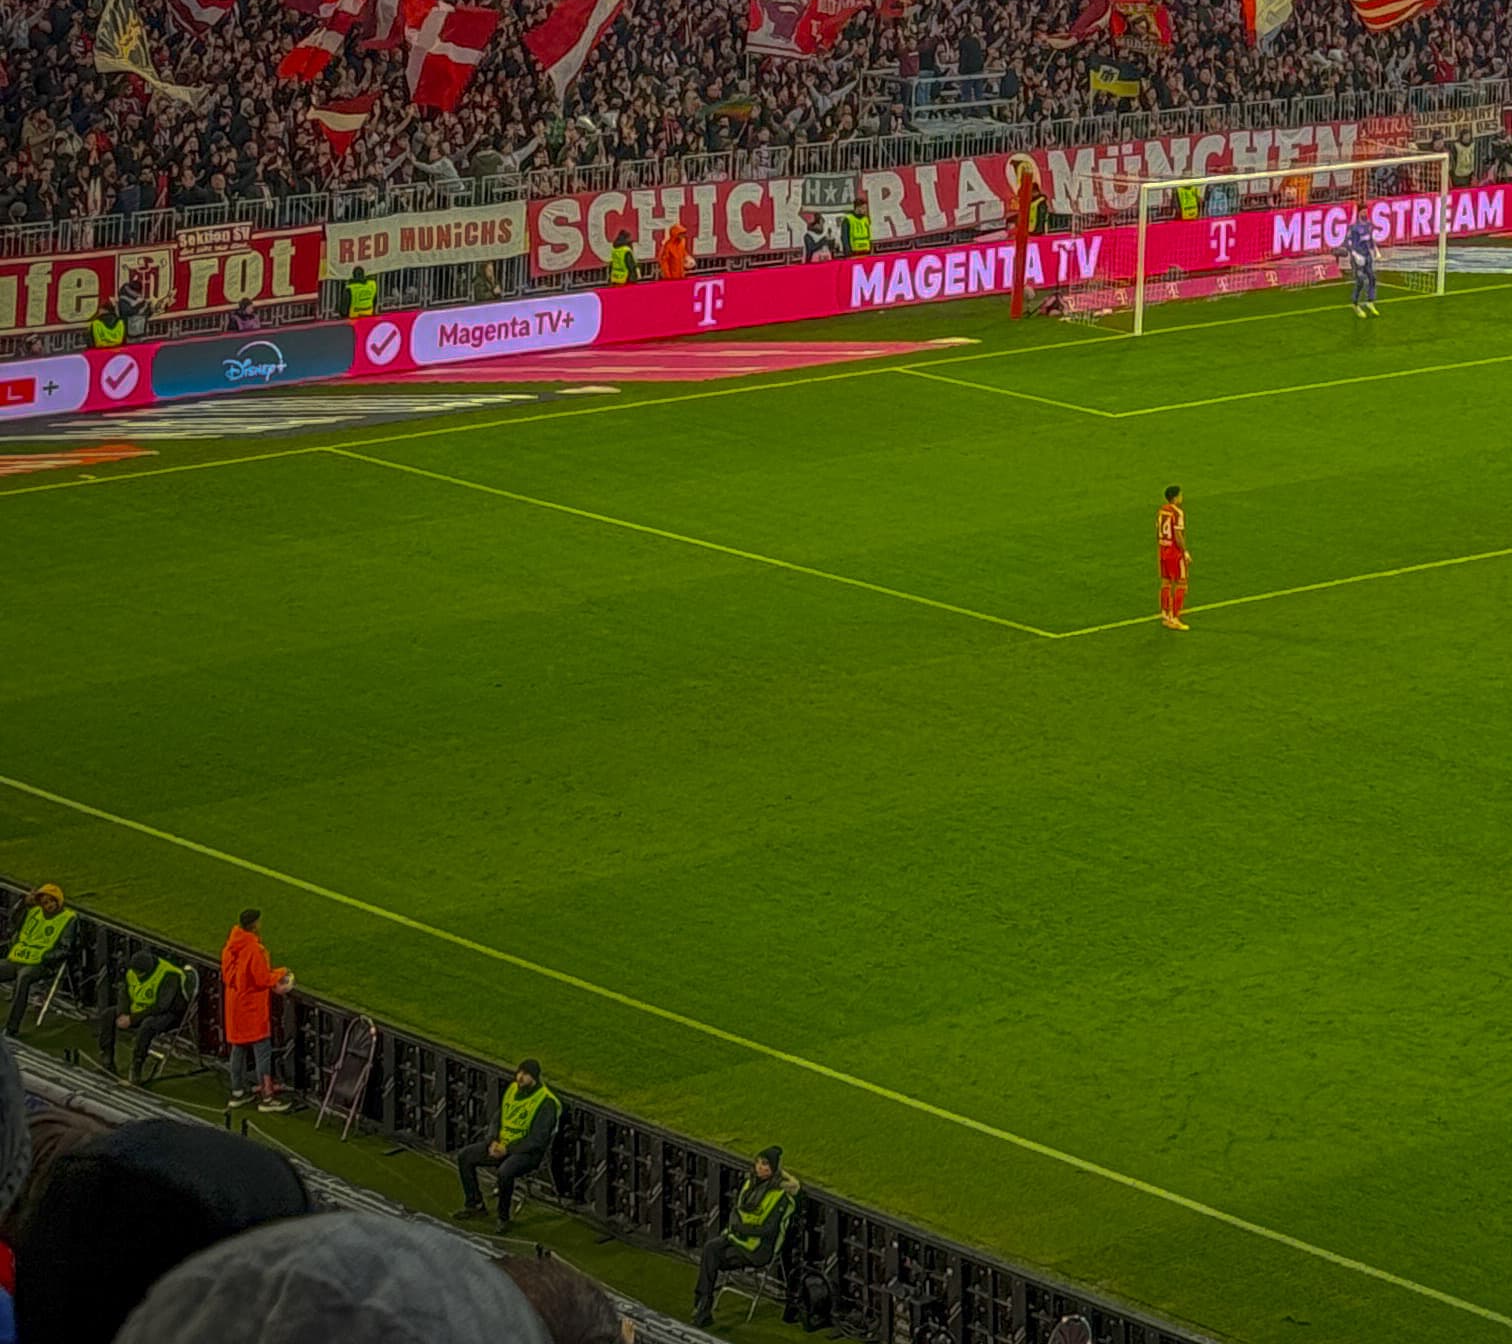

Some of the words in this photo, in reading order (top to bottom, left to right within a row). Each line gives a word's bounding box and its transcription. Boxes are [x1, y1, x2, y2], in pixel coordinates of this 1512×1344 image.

[339, 230, 389, 264] RED
[537, 161, 1005, 274] SCHICKRIA
[1271, 189, 1505, 257] MEGSTREAM
[187, 237, 297, 310] rot
[850, 242, 1045, 309] MAGENTA
[1051, 235, 1103, 282] TV
[438, 317, 531, 349] Magenta
[534, 311, 575, 336] TV+
[222, 355, 288, 383] Disney+
